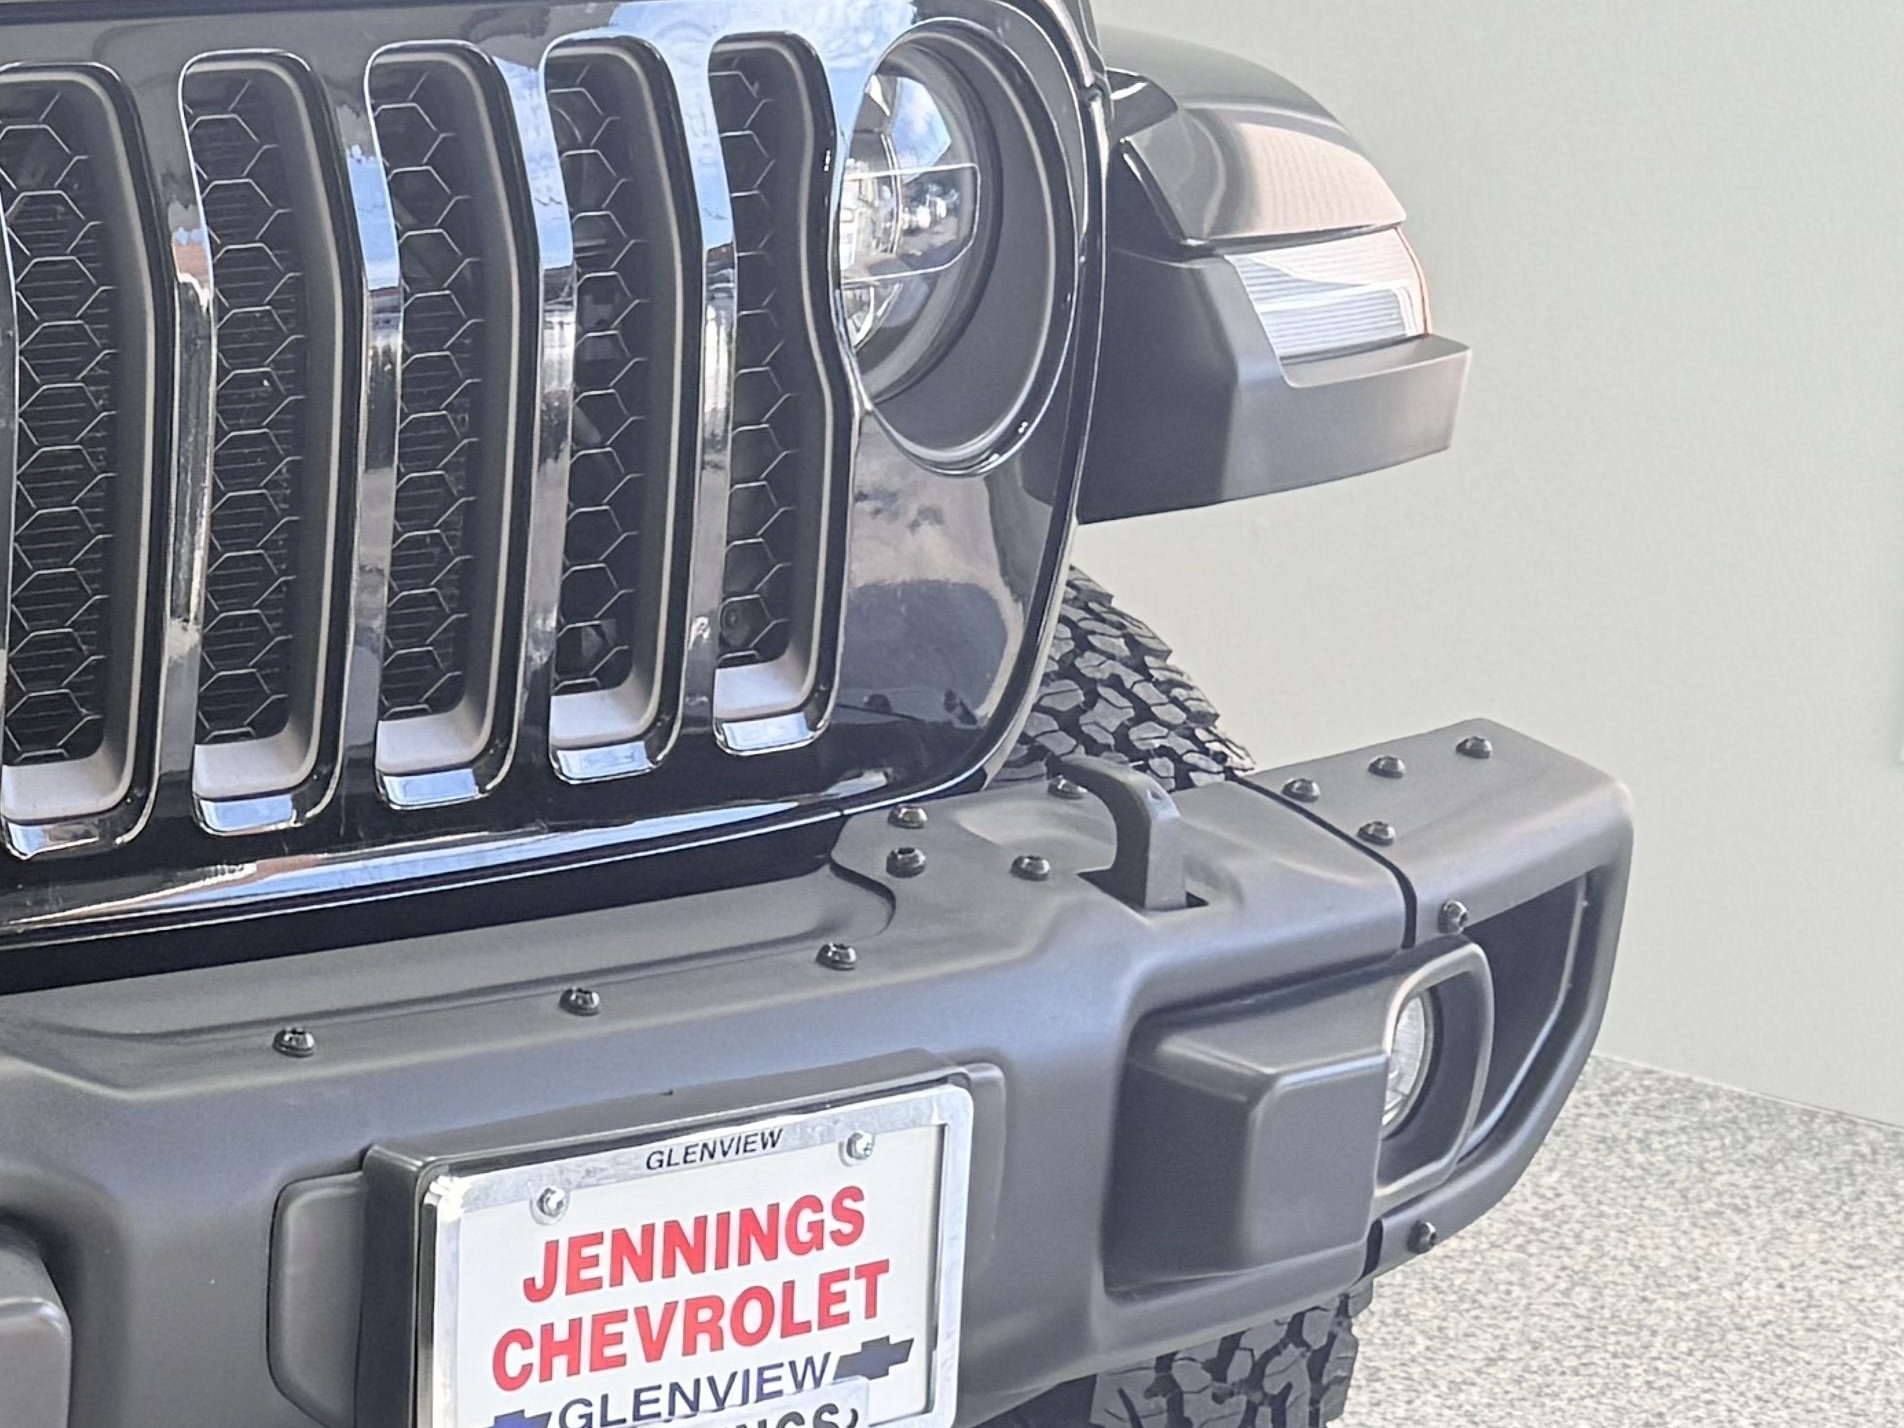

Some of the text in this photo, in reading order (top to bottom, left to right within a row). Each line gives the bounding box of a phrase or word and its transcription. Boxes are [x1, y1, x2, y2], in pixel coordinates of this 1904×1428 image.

[645, 1128, 784, 1172] GLENVIEW
[523, 1185, 866, 1303] JENNINGS
[491, 1258, 890, 1392] CHEVROLET
